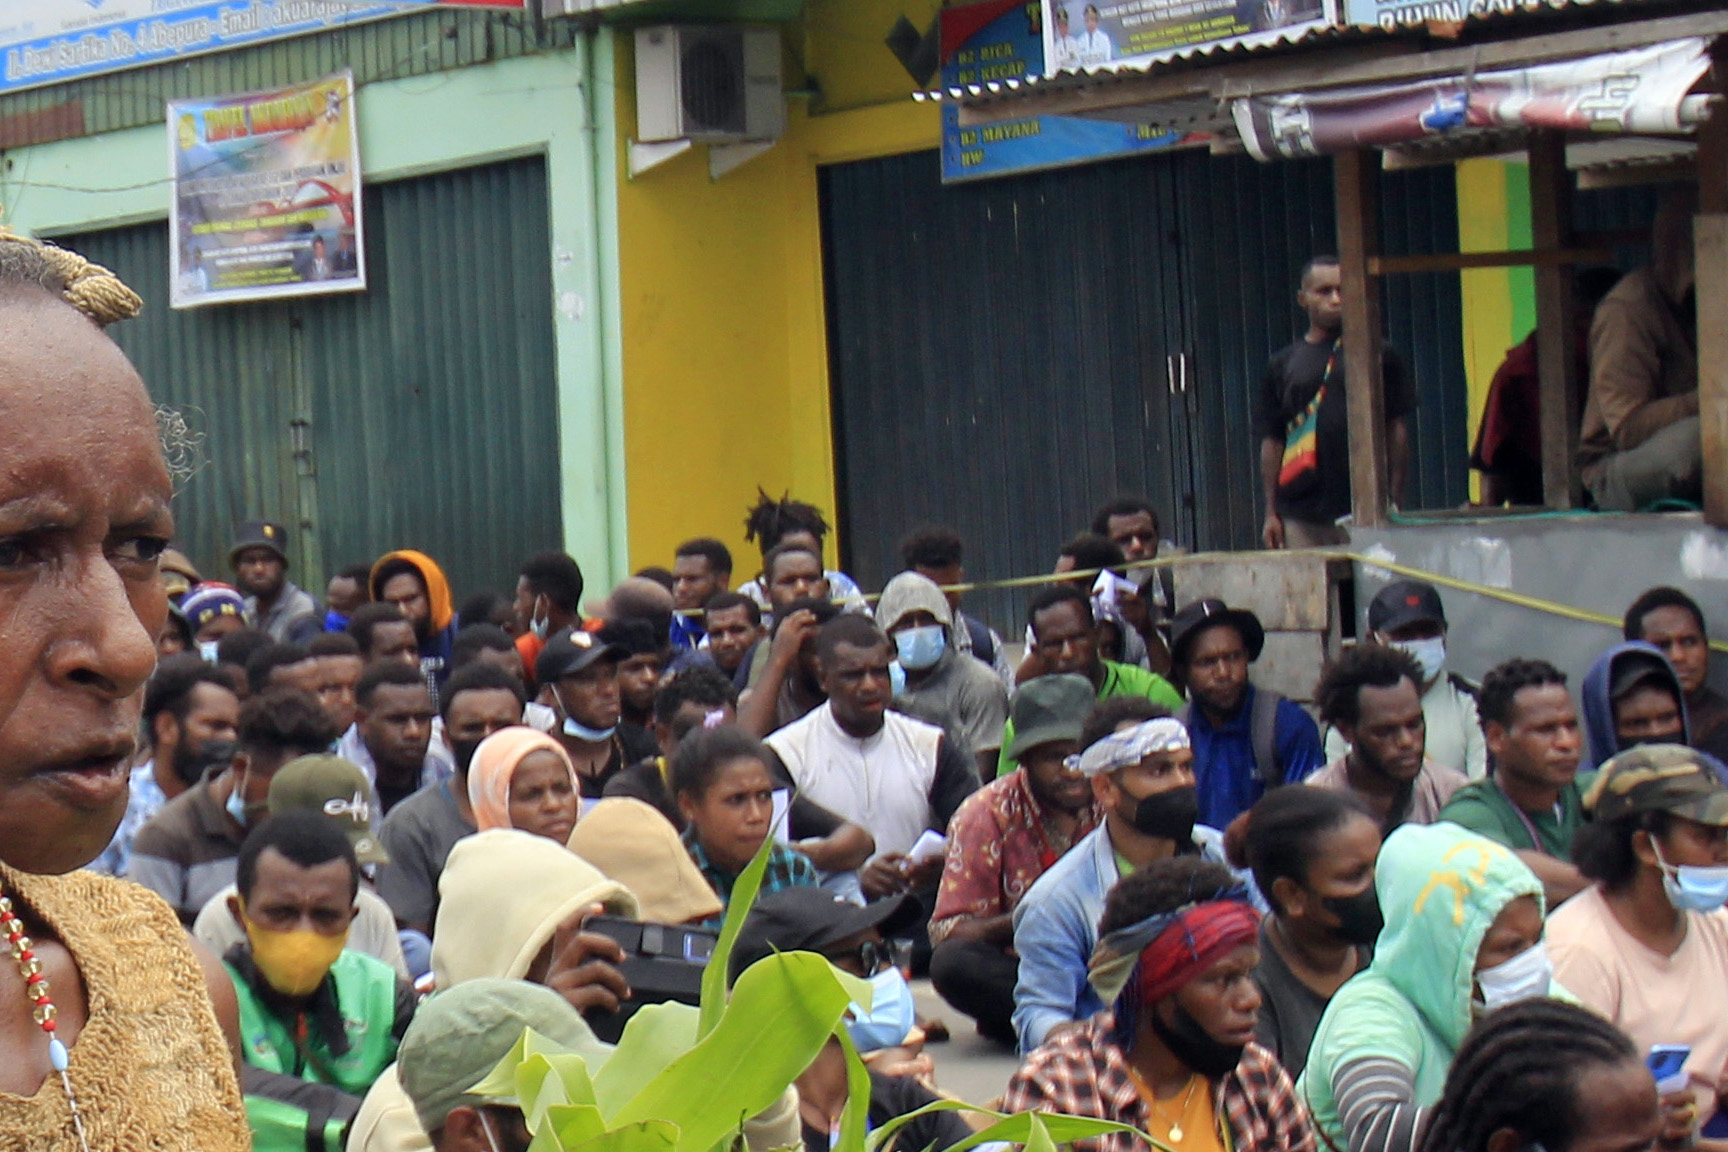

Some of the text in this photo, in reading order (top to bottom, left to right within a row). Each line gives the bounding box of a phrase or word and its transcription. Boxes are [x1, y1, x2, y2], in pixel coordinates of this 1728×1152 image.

[25, 44, 54, 74] Dewi
[60, 35, 107, 66] Sartika
[151, 15, 209, 53] Abepura
[220, 4, 260, 36] Email
